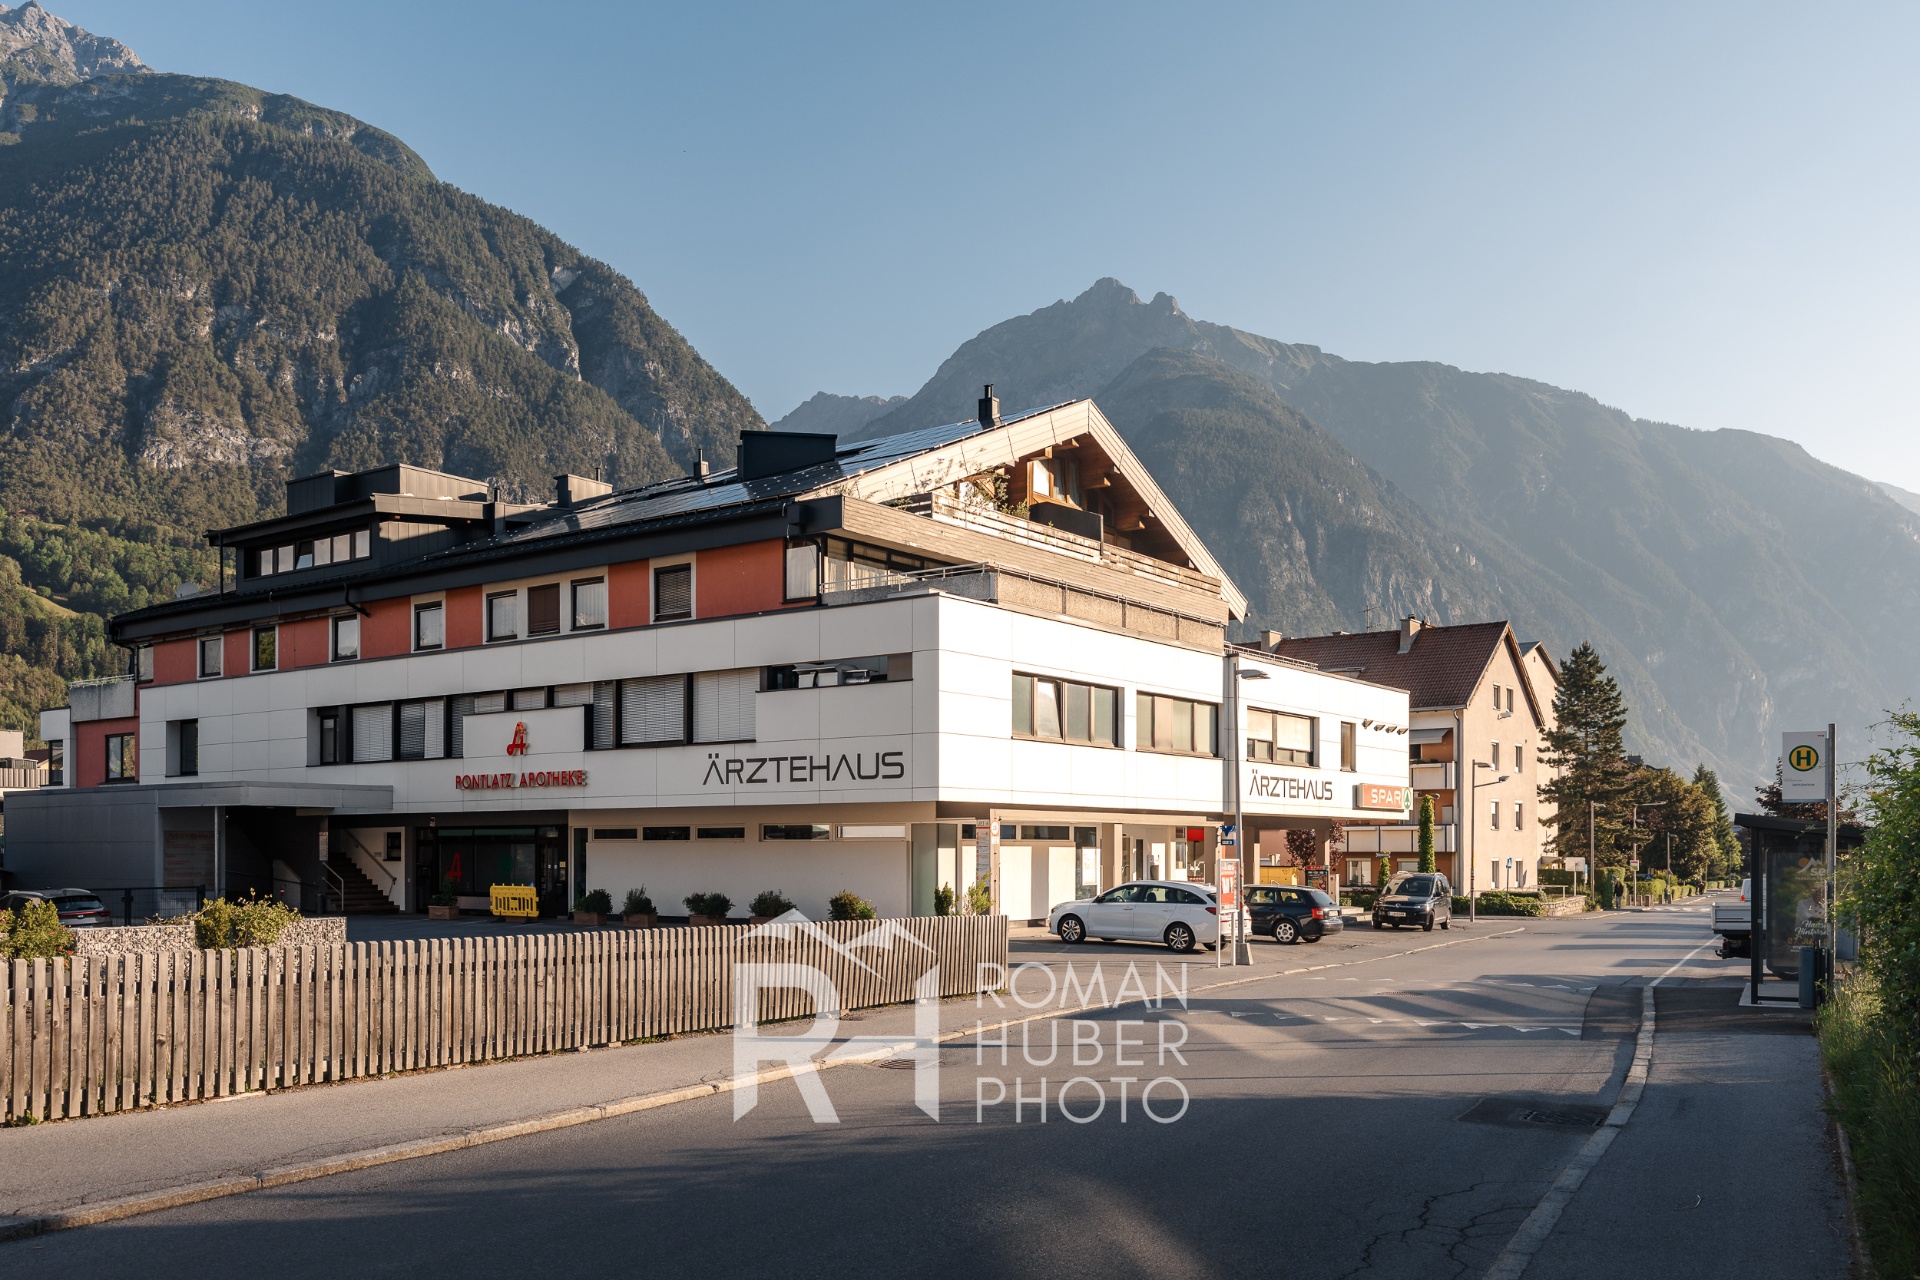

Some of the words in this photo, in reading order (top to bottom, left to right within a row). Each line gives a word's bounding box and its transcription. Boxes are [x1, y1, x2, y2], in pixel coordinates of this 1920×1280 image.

[506, 721, 527, 756] A
[703, 752, 905, 785] ÄRZTEHAUS
[1796, 750, 1812, 767] H
[455, 773, 513, 790] PONTLATZ
[519, 769, 586, 787] APOTHEKE
[1249, 768, 1333, 801] ÄRZTEHAUS
[1371, 788, 1402, 805] SPAR
